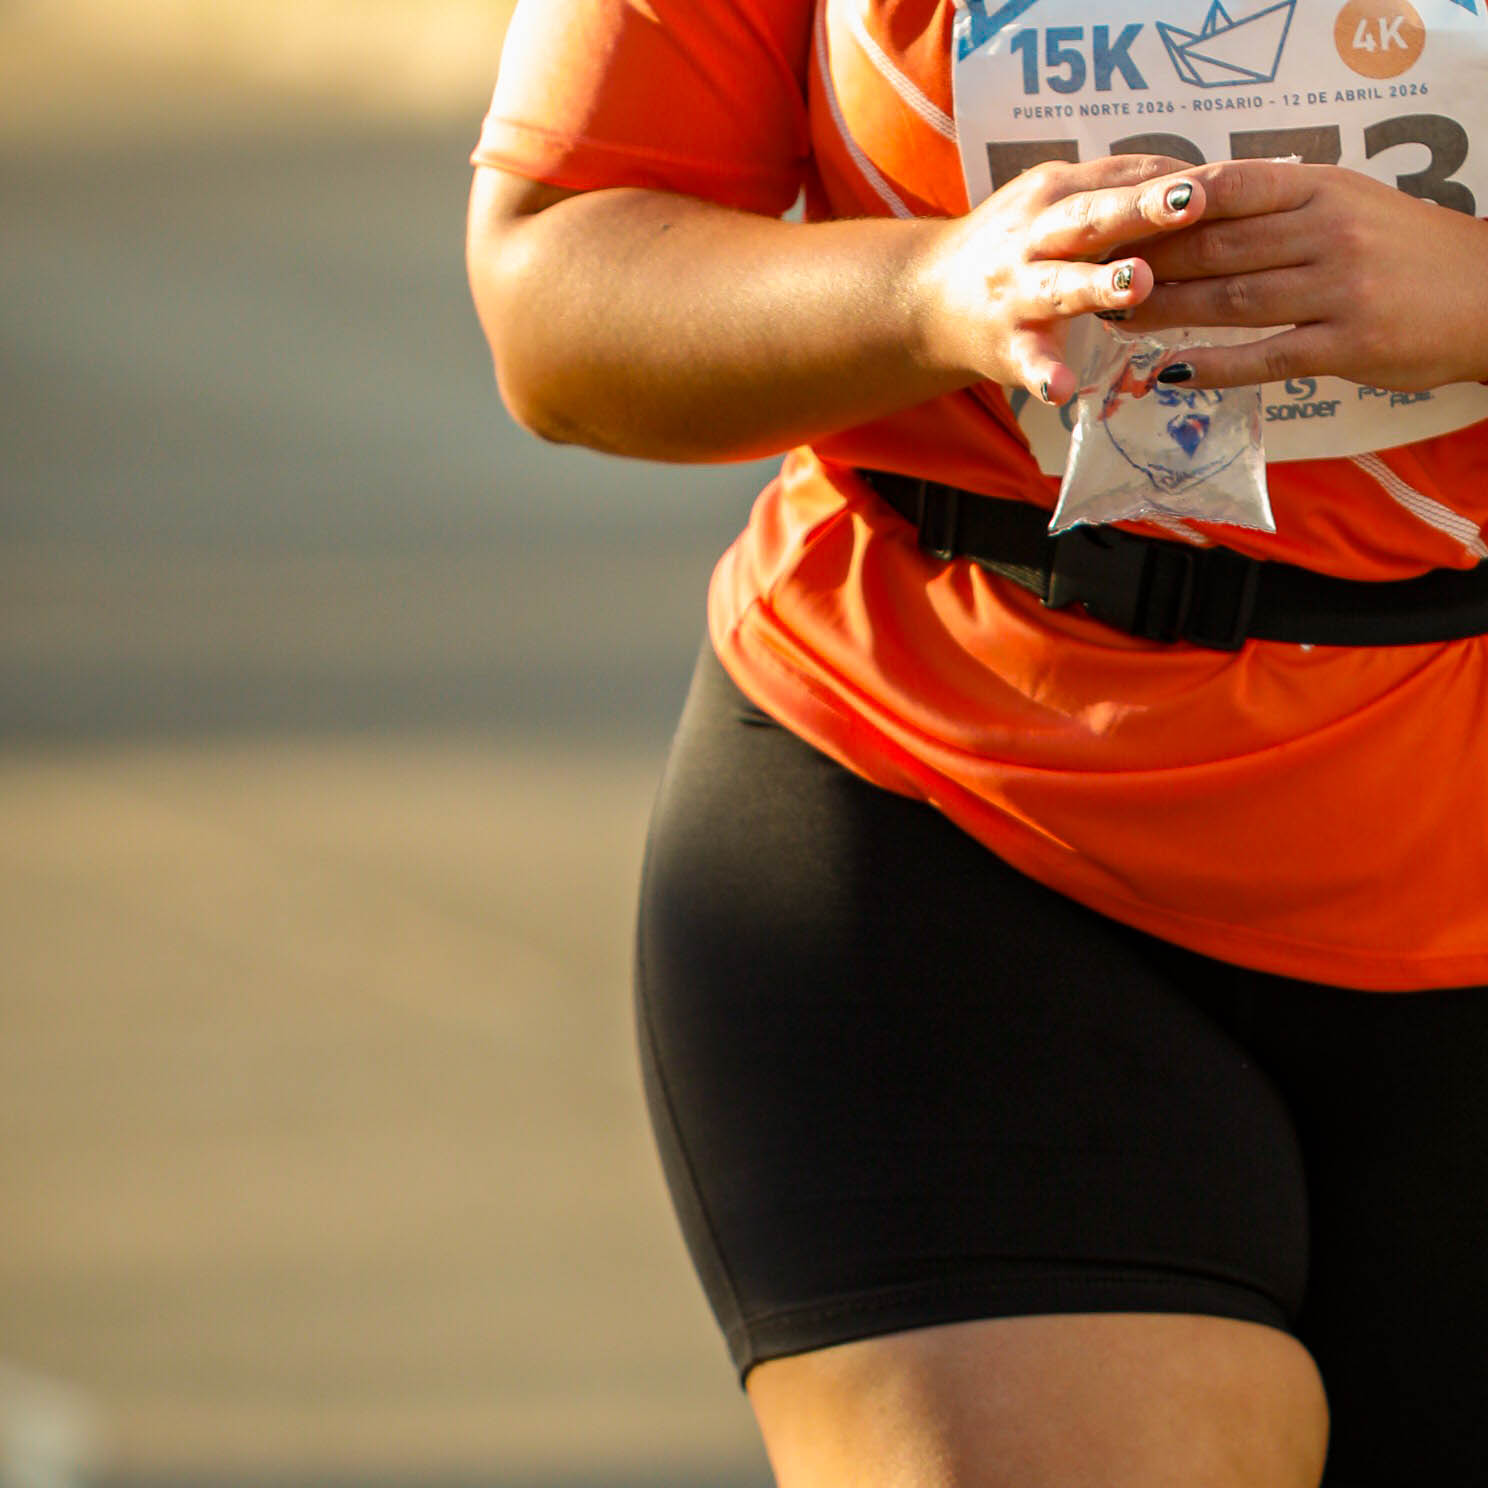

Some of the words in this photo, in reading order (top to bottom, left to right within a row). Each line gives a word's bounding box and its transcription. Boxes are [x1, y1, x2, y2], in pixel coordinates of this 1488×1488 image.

[1352, 15, 1408, 52] 4K
[1010, 23, 1149, 95] 15K
[1013, 104, 1074, 120] PUERTO
[1079, 102, 1130, 117] NORTE
[1137, 100, 1175, 114] 2026
[1192, 95, 1264, 112] ROSARIO
[1282, 93, 1300, 106] 12
[1307, 91, 1328, 105] DE
[1334, 87, 1383, 102] ABRIL
[1389, 82, 1429, 98] 2026
